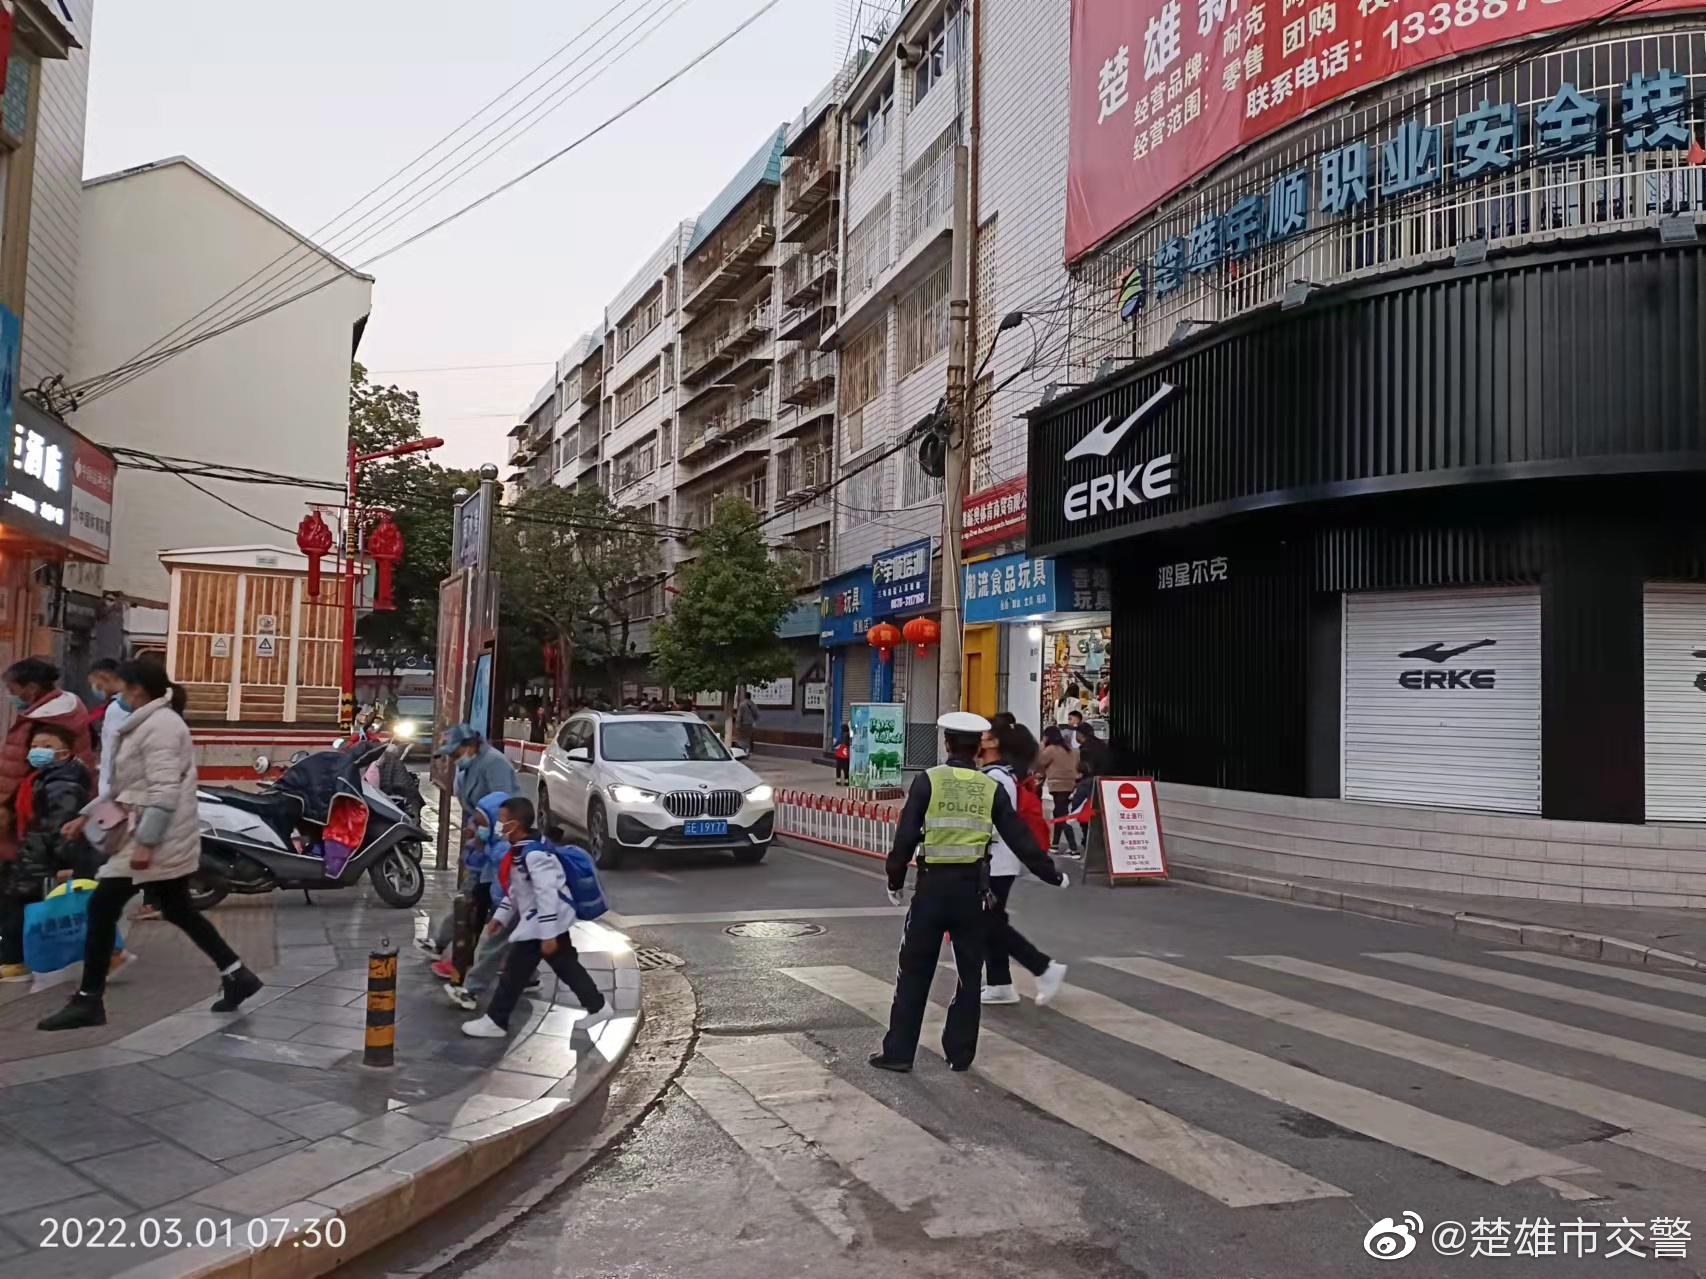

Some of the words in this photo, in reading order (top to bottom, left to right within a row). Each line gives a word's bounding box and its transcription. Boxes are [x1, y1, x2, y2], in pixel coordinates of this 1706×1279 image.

[1222, 43, 1265, 91] 零售
[1282, 1, 1337, 59] 团购
[1223, 3, 1266, 57] 耐克
[1064, 453, 1172, 521] ERKE
[1158, 556, 1228, 589] 鸿星尔克
[1399, 670, 1496, 689] ERKE
[942, 779, 986, 802] 警察
[938, 801, 985, 816] POLICE
